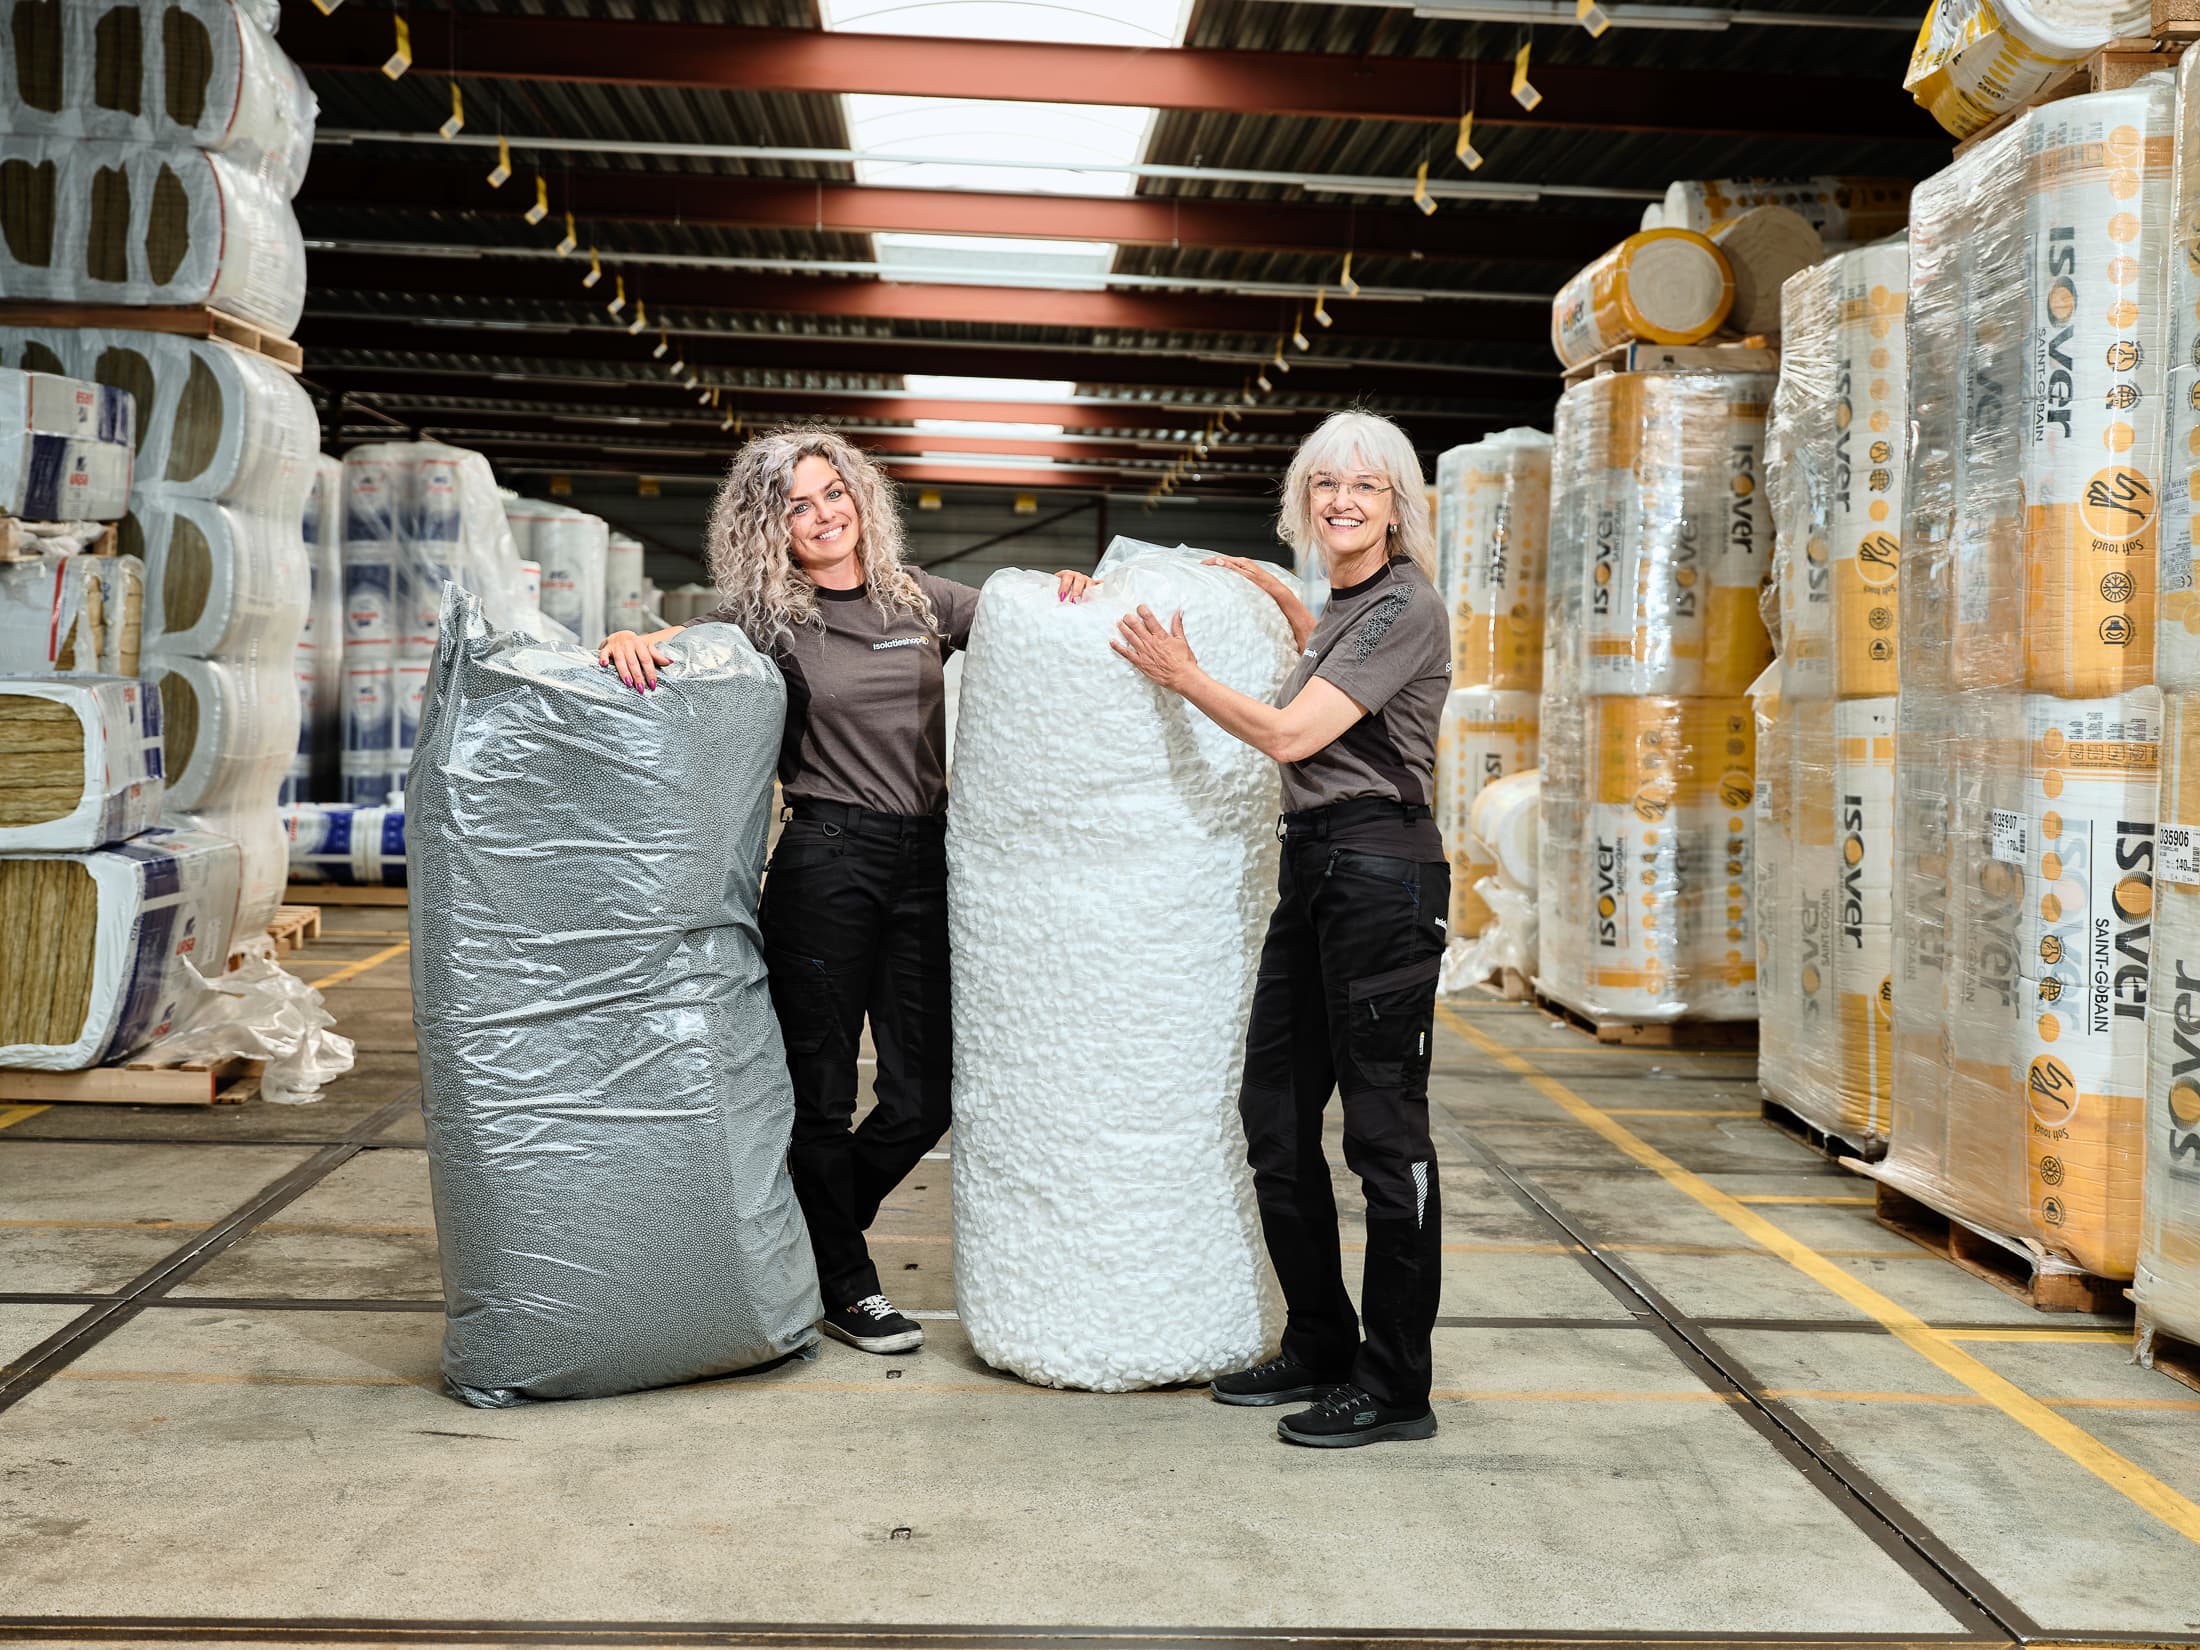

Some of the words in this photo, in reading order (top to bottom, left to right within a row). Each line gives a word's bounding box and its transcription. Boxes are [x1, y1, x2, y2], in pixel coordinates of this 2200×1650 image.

[2035, 328, 2047, 442] SAINT-GOBAIN
[2091, 539, 2119, 555] touch
[2121, 539, 2144, 556] Soft
[2159, 828, 2189, 847] 035906
[2095, 918, 2110, 1033] SAINT-GOBAIN
